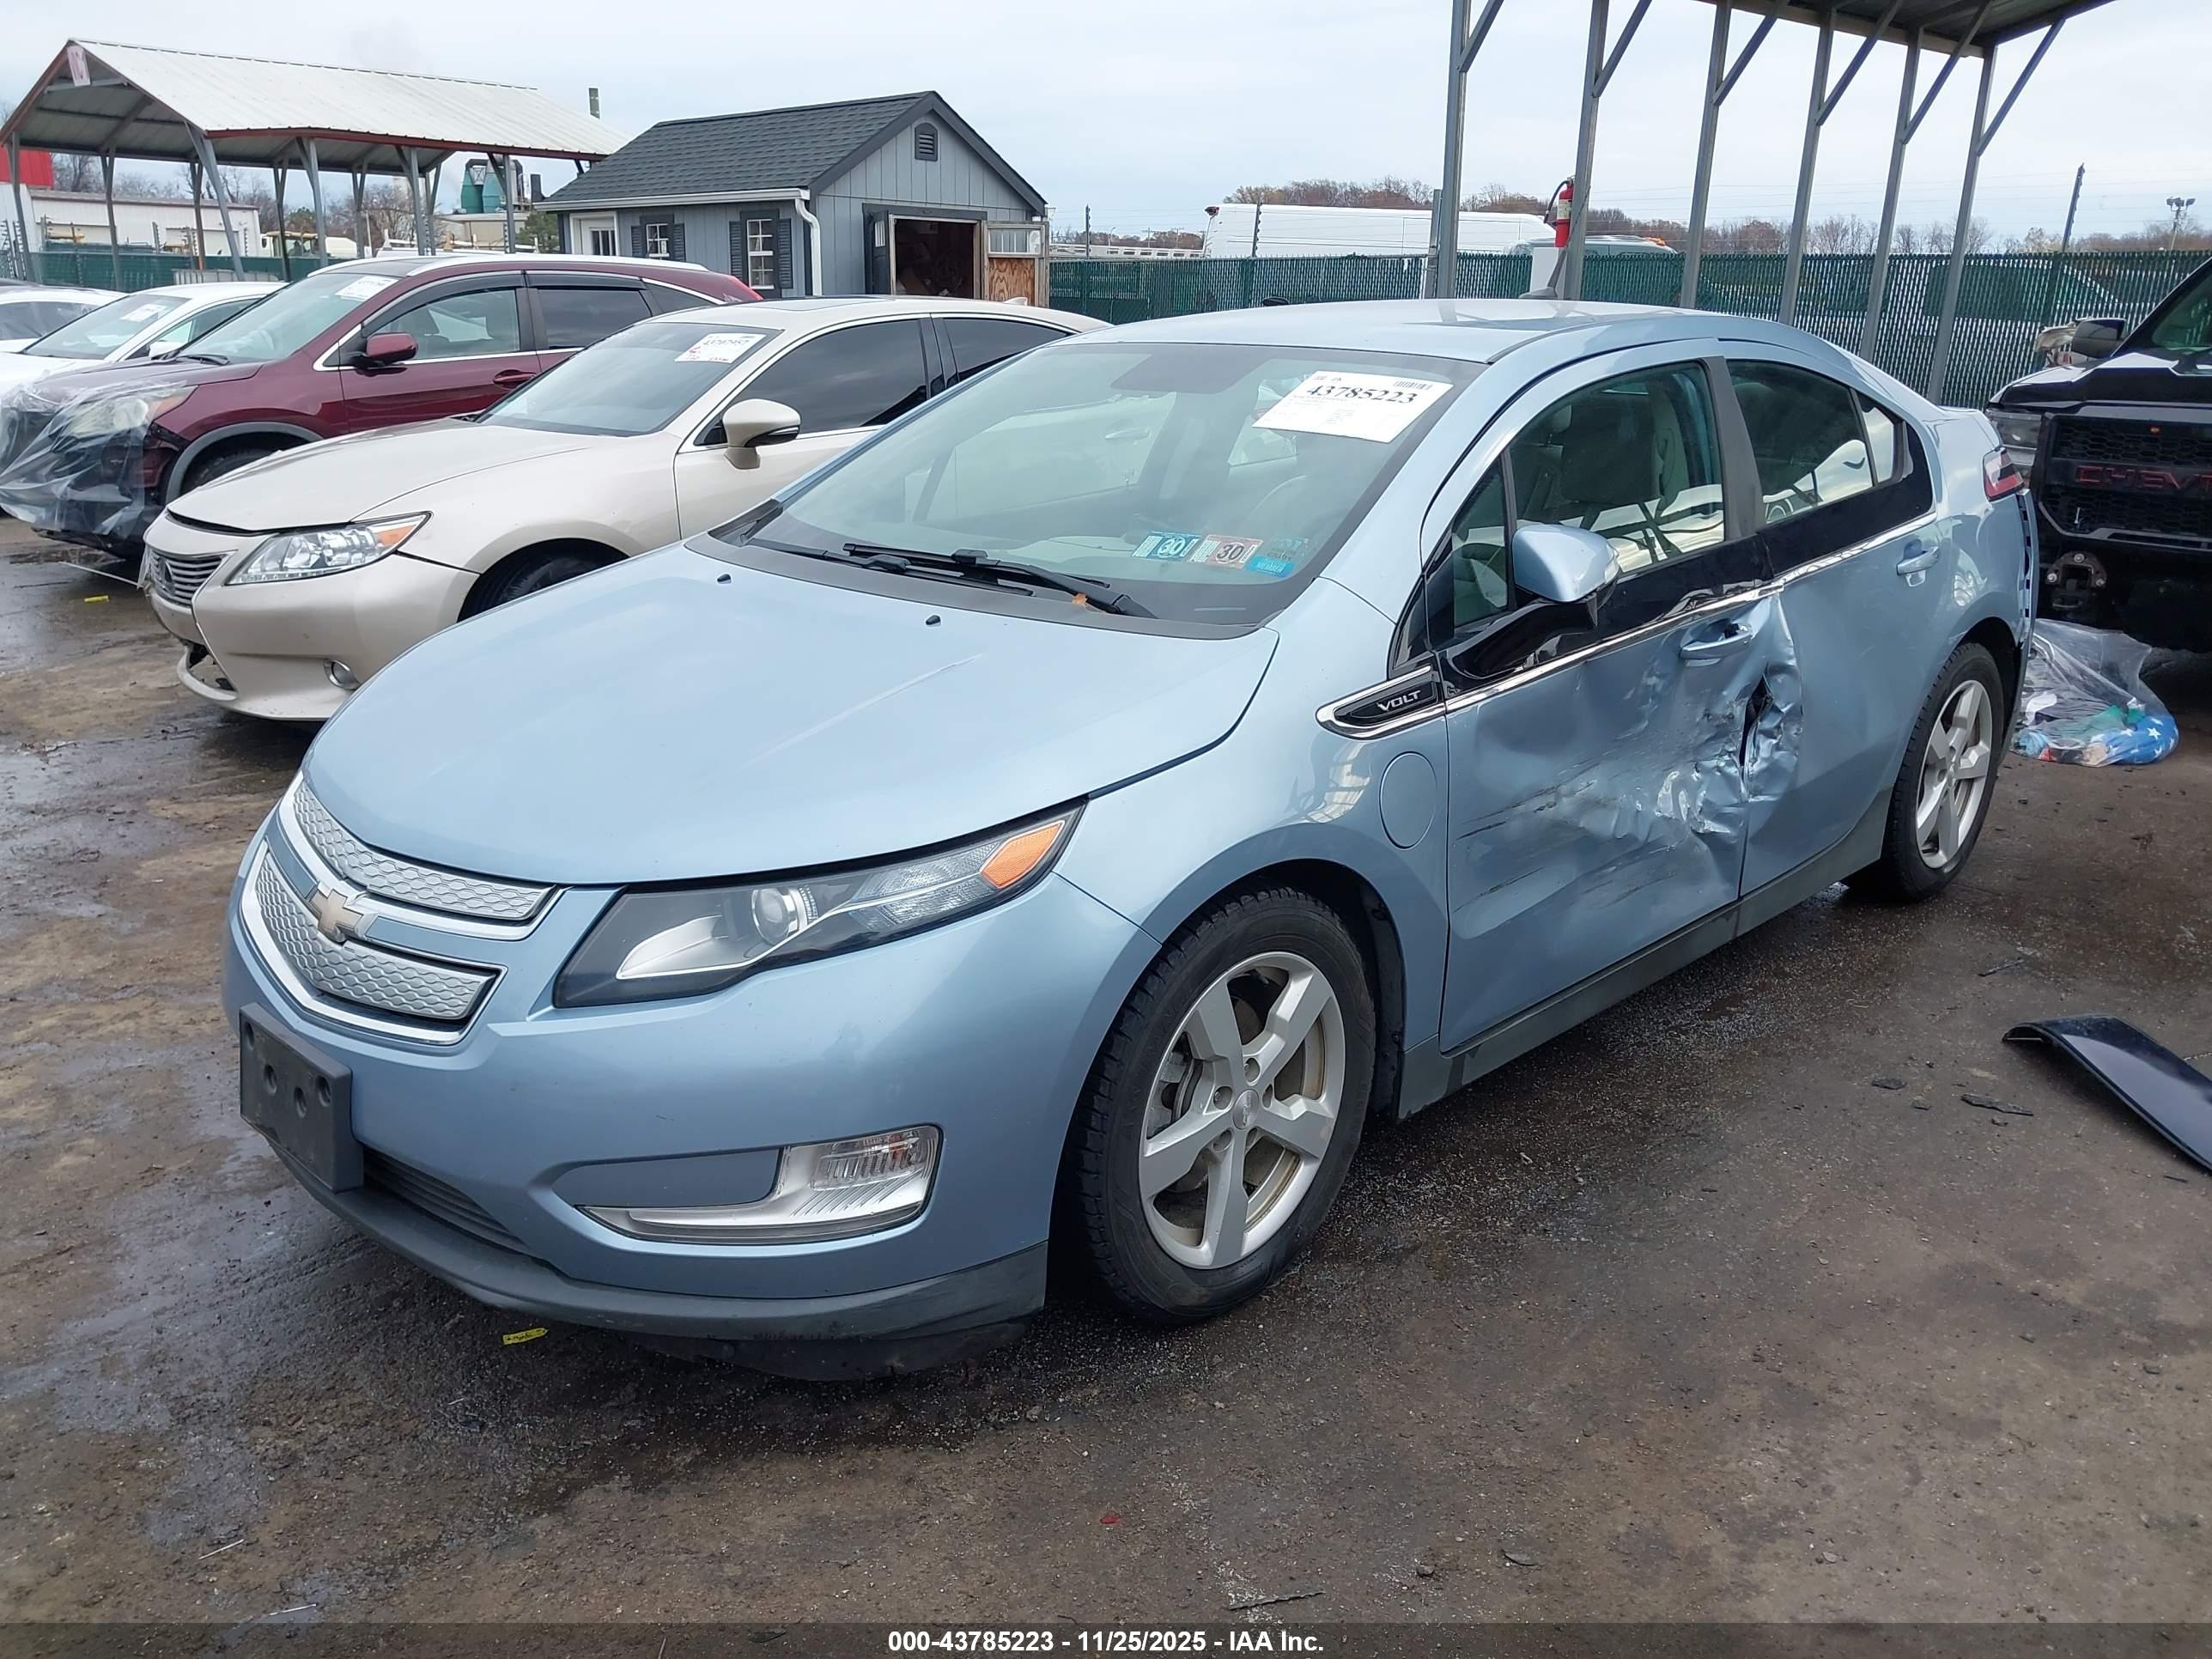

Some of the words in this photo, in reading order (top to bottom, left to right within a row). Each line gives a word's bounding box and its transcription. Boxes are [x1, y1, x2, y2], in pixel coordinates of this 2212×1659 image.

[1307, 385, 1419, 404] 43785223
[1216, 544, 1245, 561] 30
[1376, 690, 1421, 711] VOLT
